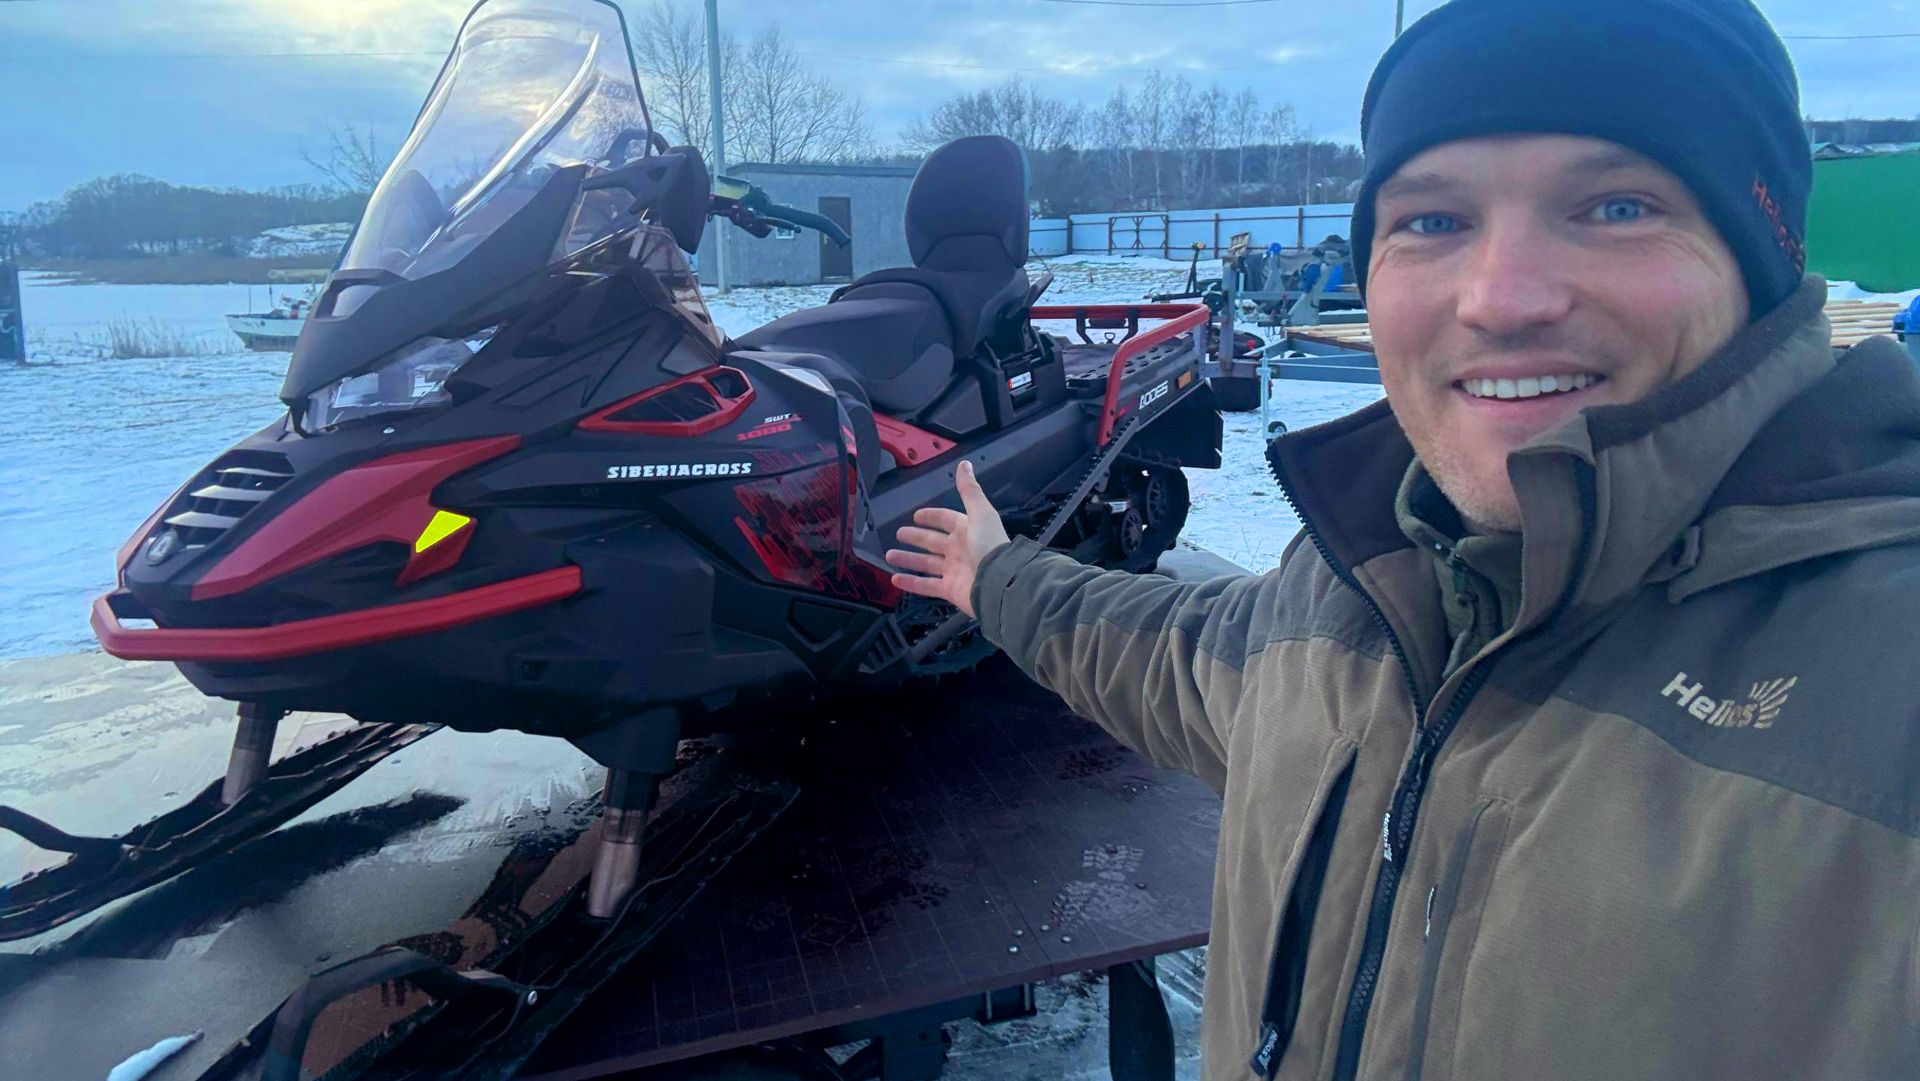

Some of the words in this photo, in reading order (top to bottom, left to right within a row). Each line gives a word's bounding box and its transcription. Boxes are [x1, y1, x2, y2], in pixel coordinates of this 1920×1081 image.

[736, 423, 793, 441] 1000
[607, 462, 752, 479] SIBERIACROSS
[1660, 671, 1756, 728] Helios
